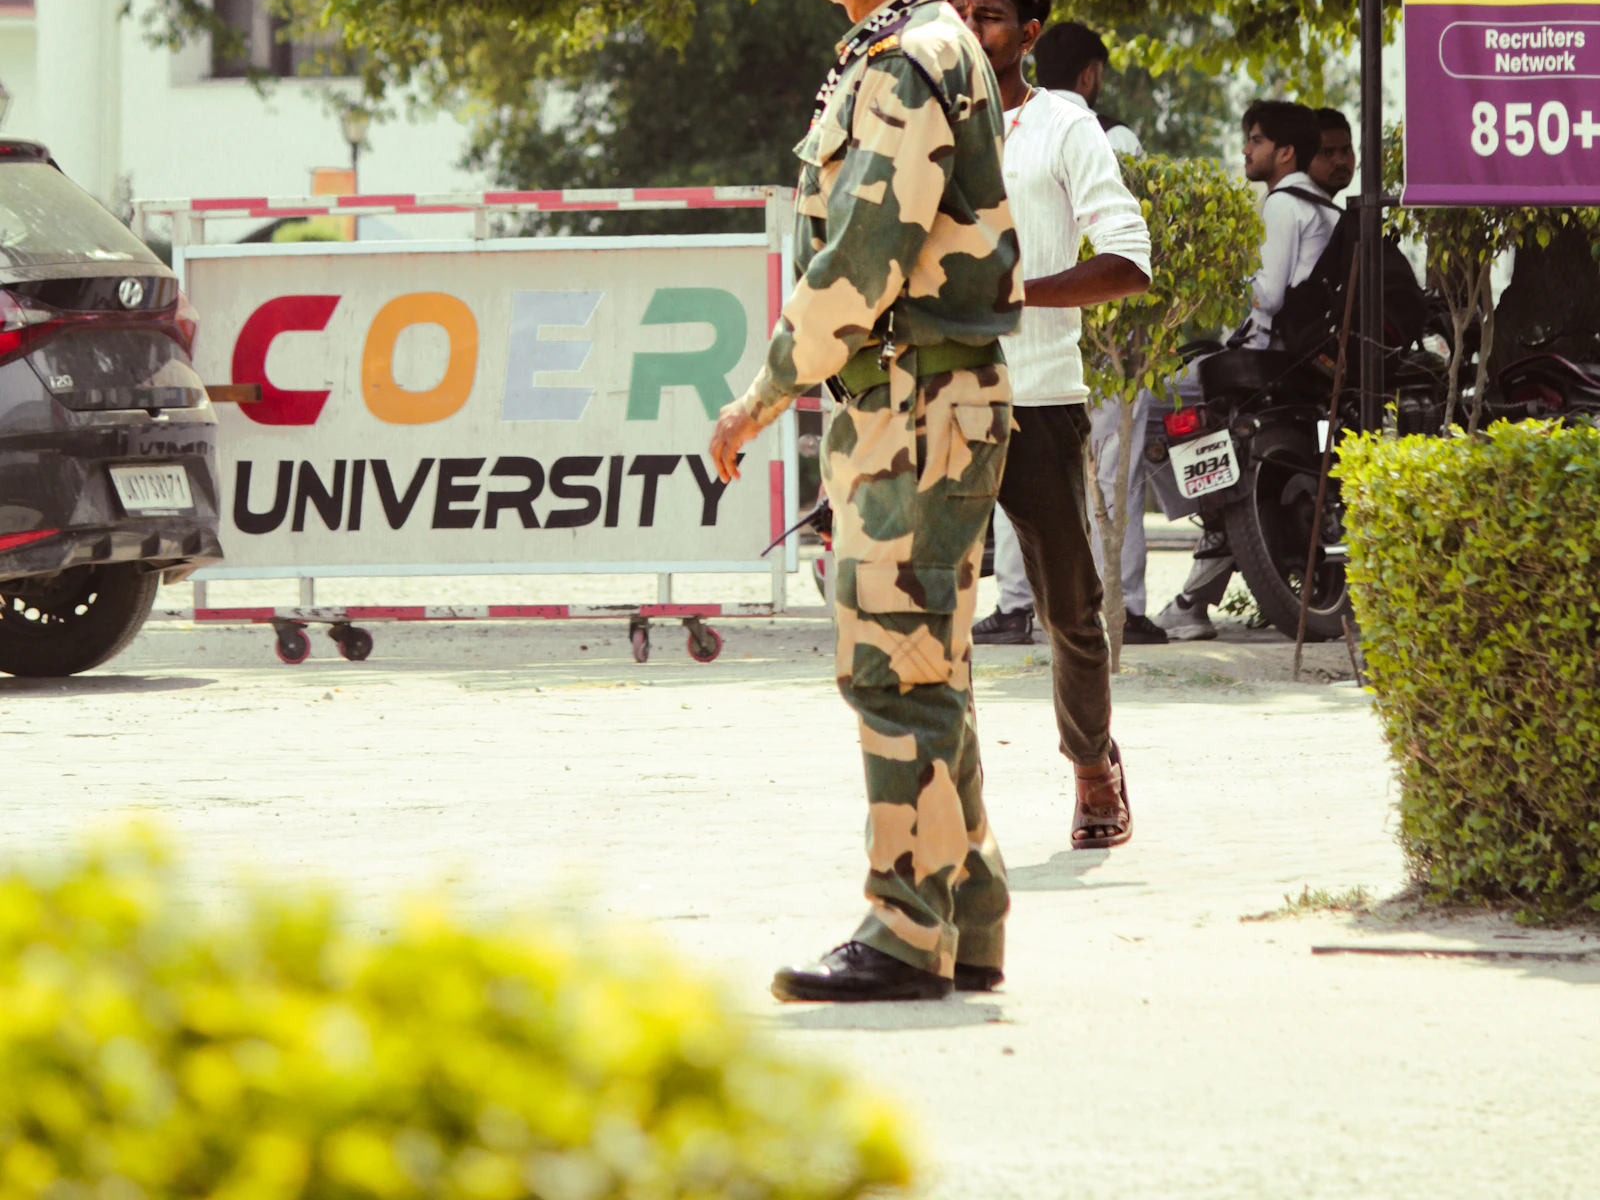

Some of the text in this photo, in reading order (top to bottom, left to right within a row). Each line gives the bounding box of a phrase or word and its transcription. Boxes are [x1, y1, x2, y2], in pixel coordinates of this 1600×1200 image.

[1485, 26, 1586, 50] Recruiters
[1495, 50, 1576, 73] Network
[1471, 101, 1600, 157] 850+
[231, 287, 748, 426] COER
[1183, 452, 1231, 481] 3034
[232, 452, 746, 535] UNIVERSITY
[1186, 469, 1233, 494] POLICE
